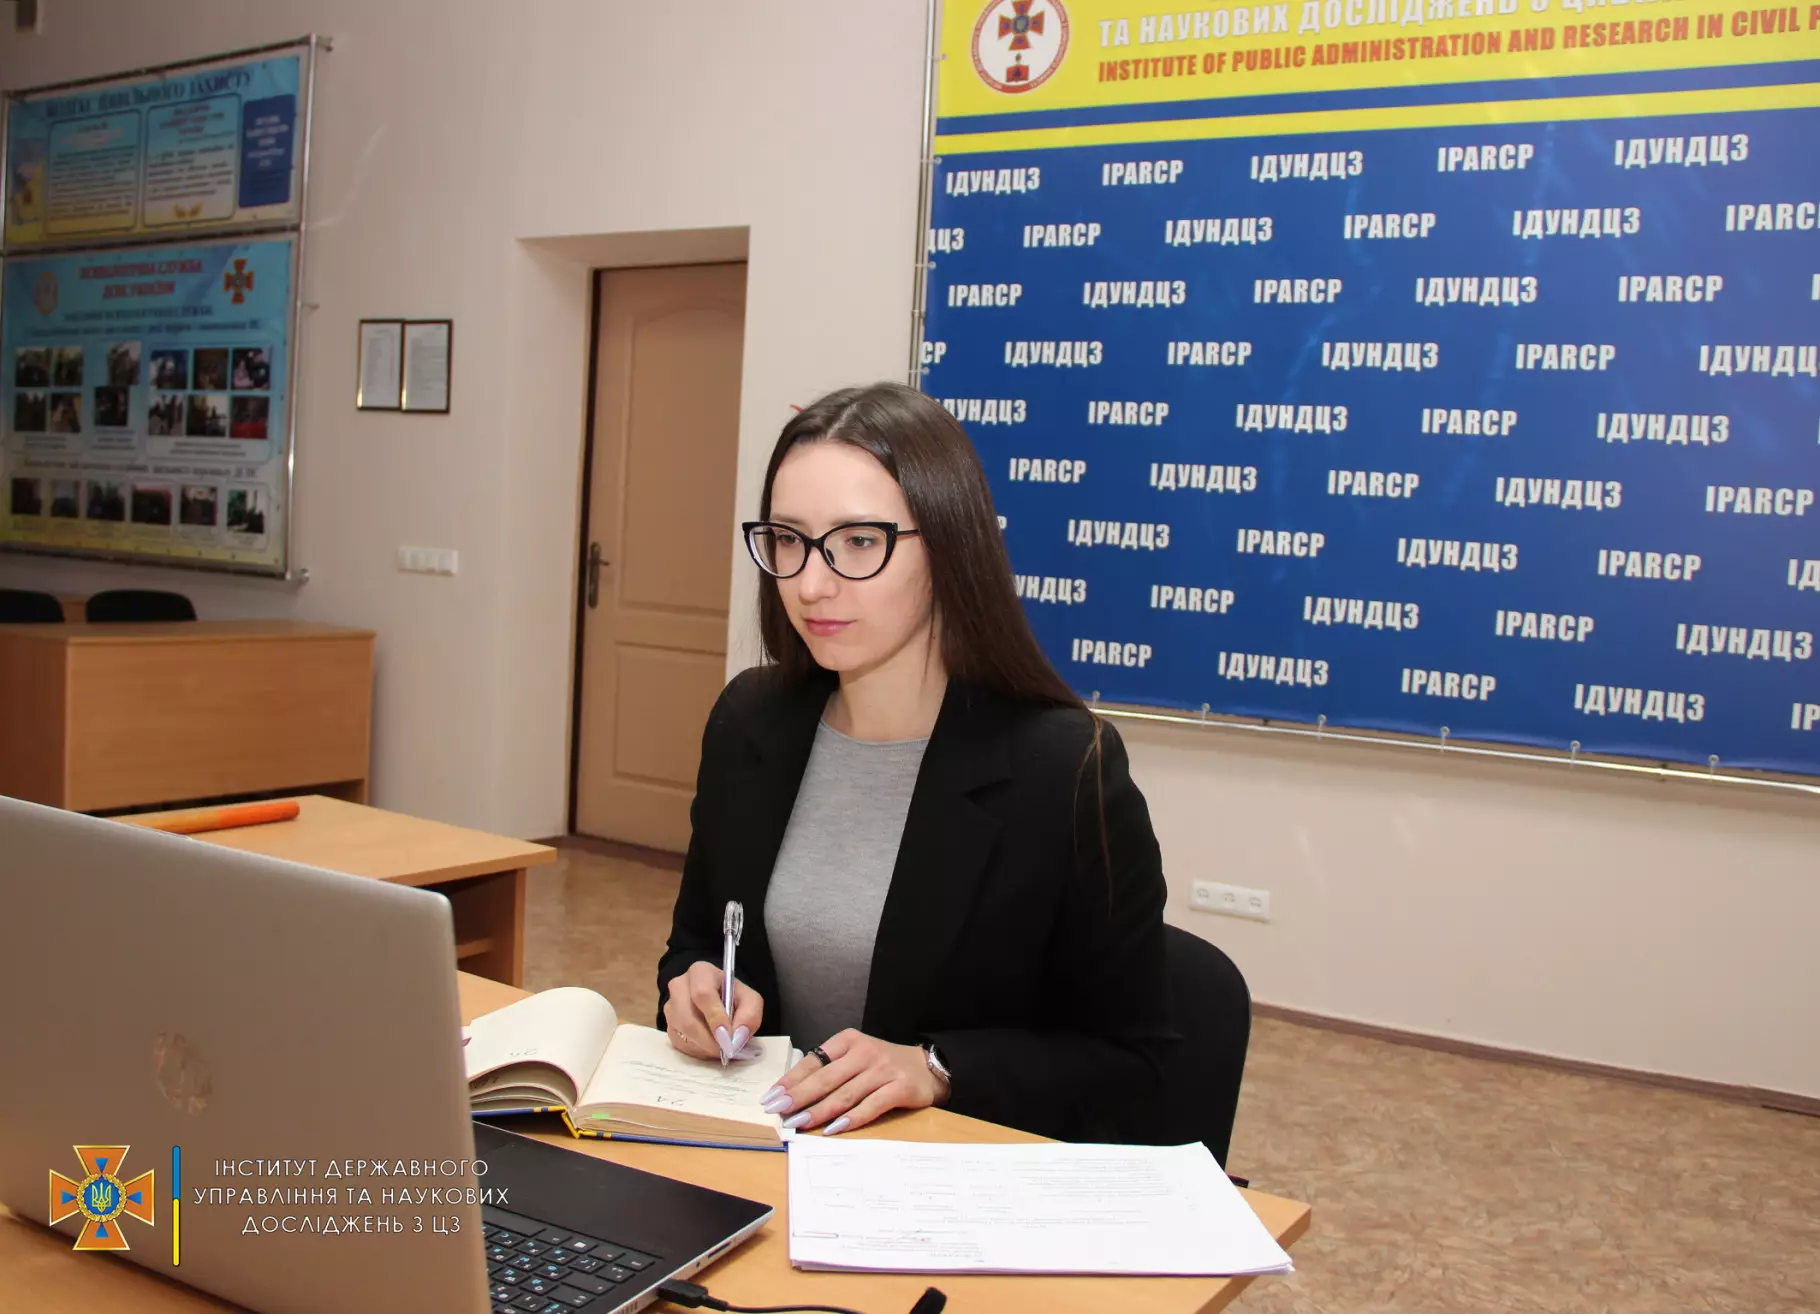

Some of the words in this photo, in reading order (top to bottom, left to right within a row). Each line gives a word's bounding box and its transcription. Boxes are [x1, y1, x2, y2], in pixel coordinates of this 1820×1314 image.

[1098, 19, 1130, 47] ТА
[1139, 3, 1289, 45] НАУКОВИХ
[1099, 55, 1197, 82] INSTITUTE
[1203, 52, 1227, 75] OF
[1232, 45, 1306, 72] PUBLIC
[1311, 31, 1501, 67] ADMINISTRATION
[1508, 27, 1555, 52] AND
[1562, 17, 1689, 49] RESEARCH
[1697, 13, 1723, 39] IN
[1731, 7, 1801, 36] CIVIL
[1438, 144, 1535, 172] IPARCP
[1615, 134, 1749, 169] ІДУНДЦЗ
[1103, 160, 1184, 186] IPARCP
[1251, 151, 1363, 182] ІДУНДЦЗ
[946, 168, 1041, 196] ІДУНДЦЗ
[1344, 213, 1437, 239] IPARCP
[1512, 207, 1641, 239] ІДУНДЦЗ
[1726, 202, 1820, 231] IPARC
[1024, 223, 1101, 248] IPARCP
[1165, 217, 1273, 246] ІДУНДЦЗ
[949, 284, 1023, 307] IPARCP
[1084, 281, 1186, 308] ІДУНДЦЗ
[1254, 279, 1342, 304] IPARCP
[1416, 276, 1538, 306] ІДУНДЦЗ
[1618, 275, 1723, 302] IPARCP
[1005, 341, 1103, 367] ІДУНДЦЗ
[1168, 342, 1252, 366] IPARCP
[1322, 342, 1439, 371] ІДУНДЦЗ
[1516, 344, 1615, 370] IPARCP
[1699, 345, 1820, 377] ІДУНДЦ
[1088, 401, 1169, 426] IPARCP
[1236, 404, 1348, 434] ІДУНДЦЗ
[1421, 409, 1517, 436] IPARCP
[1597, 413, 1730, 446] ІДУНДЦЗ
[1010, 458, 1087, 483] IPARCP
[1150, 463, 1258, 493] ІДУНДЦЗ
[1328, 470, 1419, 497] IPARCP
[1496, 477, 1623, 510] ІДУНДЦЗ
[1706, 486, 1814, 517] IPARCP
[1067, 519, 1170, 550] ІДУНДЦЗ
[1237, 529, 1325, 558] IPARCP
[1398, 538, 1518, 573] ІДУНДЦЗ
[1598, 550, 1701, 581] IPARCP
[1151, 585, 1235, 614] IPARCP
[1304, 596, 1419, 631] ІДУНДЦЗ
[1495, 610, 1594, 642] IPARCP
[1072, 639, 1152, 668] IPARCP
[1676, 624, 1813, 662] ІДУНДЦЗ
[1218, 651, 1329, 688] ІДУНДЦЗ
[1401, 668, 1496, 701] IPARCP
[1574, 684, 1705, 724] ІДУНДЦЗ
